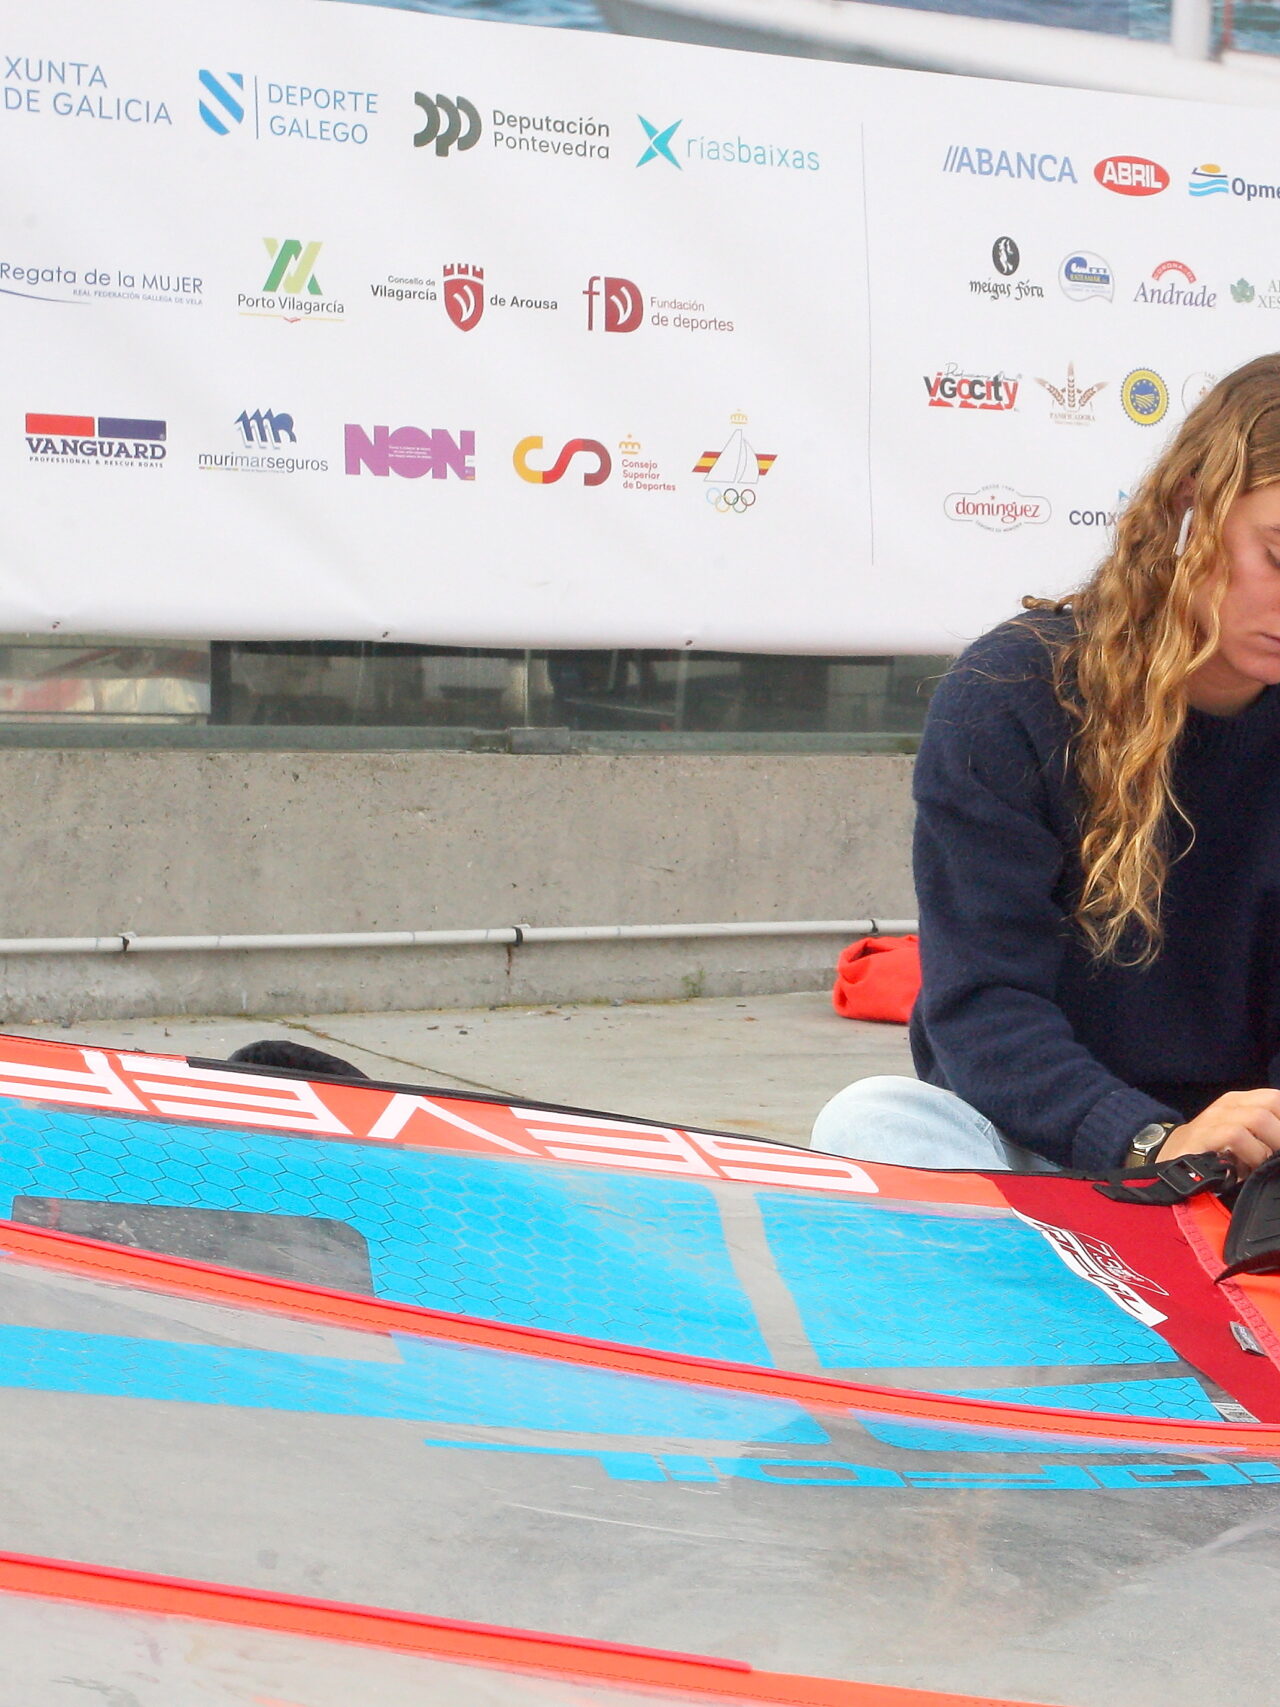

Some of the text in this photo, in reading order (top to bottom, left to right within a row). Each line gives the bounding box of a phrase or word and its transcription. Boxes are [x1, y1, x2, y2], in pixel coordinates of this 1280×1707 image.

[5, 57, 107, 88] XUNTA
[4, 87, 172, 125] DE GALICIA
[268, 84, 378, 114] DEPORTE
[270, 116, 368, 144] GALEGO
[492, 110, 609, 137] Deputación
[493, 132, 609, 159] Pontevedra
[1102, 161, 1162, 188] ABRIL
[1, 262, 203, 294] Regata de la MUJER
[238, 294, 344, 314] Porto Vilagarcía
[371, 284, 437, 302] Vilagarcía
[490, 295, 558, 310] de Arousa
[1133, 282, 1217, 308] Andrade
[650, 297, 704, 312] Fundación
[651, 312, 734, 333] de deportes
[26, 437, 166, 460] VANGUARD
[29, 456, 91, 466] PROFESSIONAL
[198, 451, 328, 473] murimarseguros
[621, 459, 658, 471] Consejo
[623, 470, 660, 481] Superior
[623, 481, 676, 492] de Deportes
